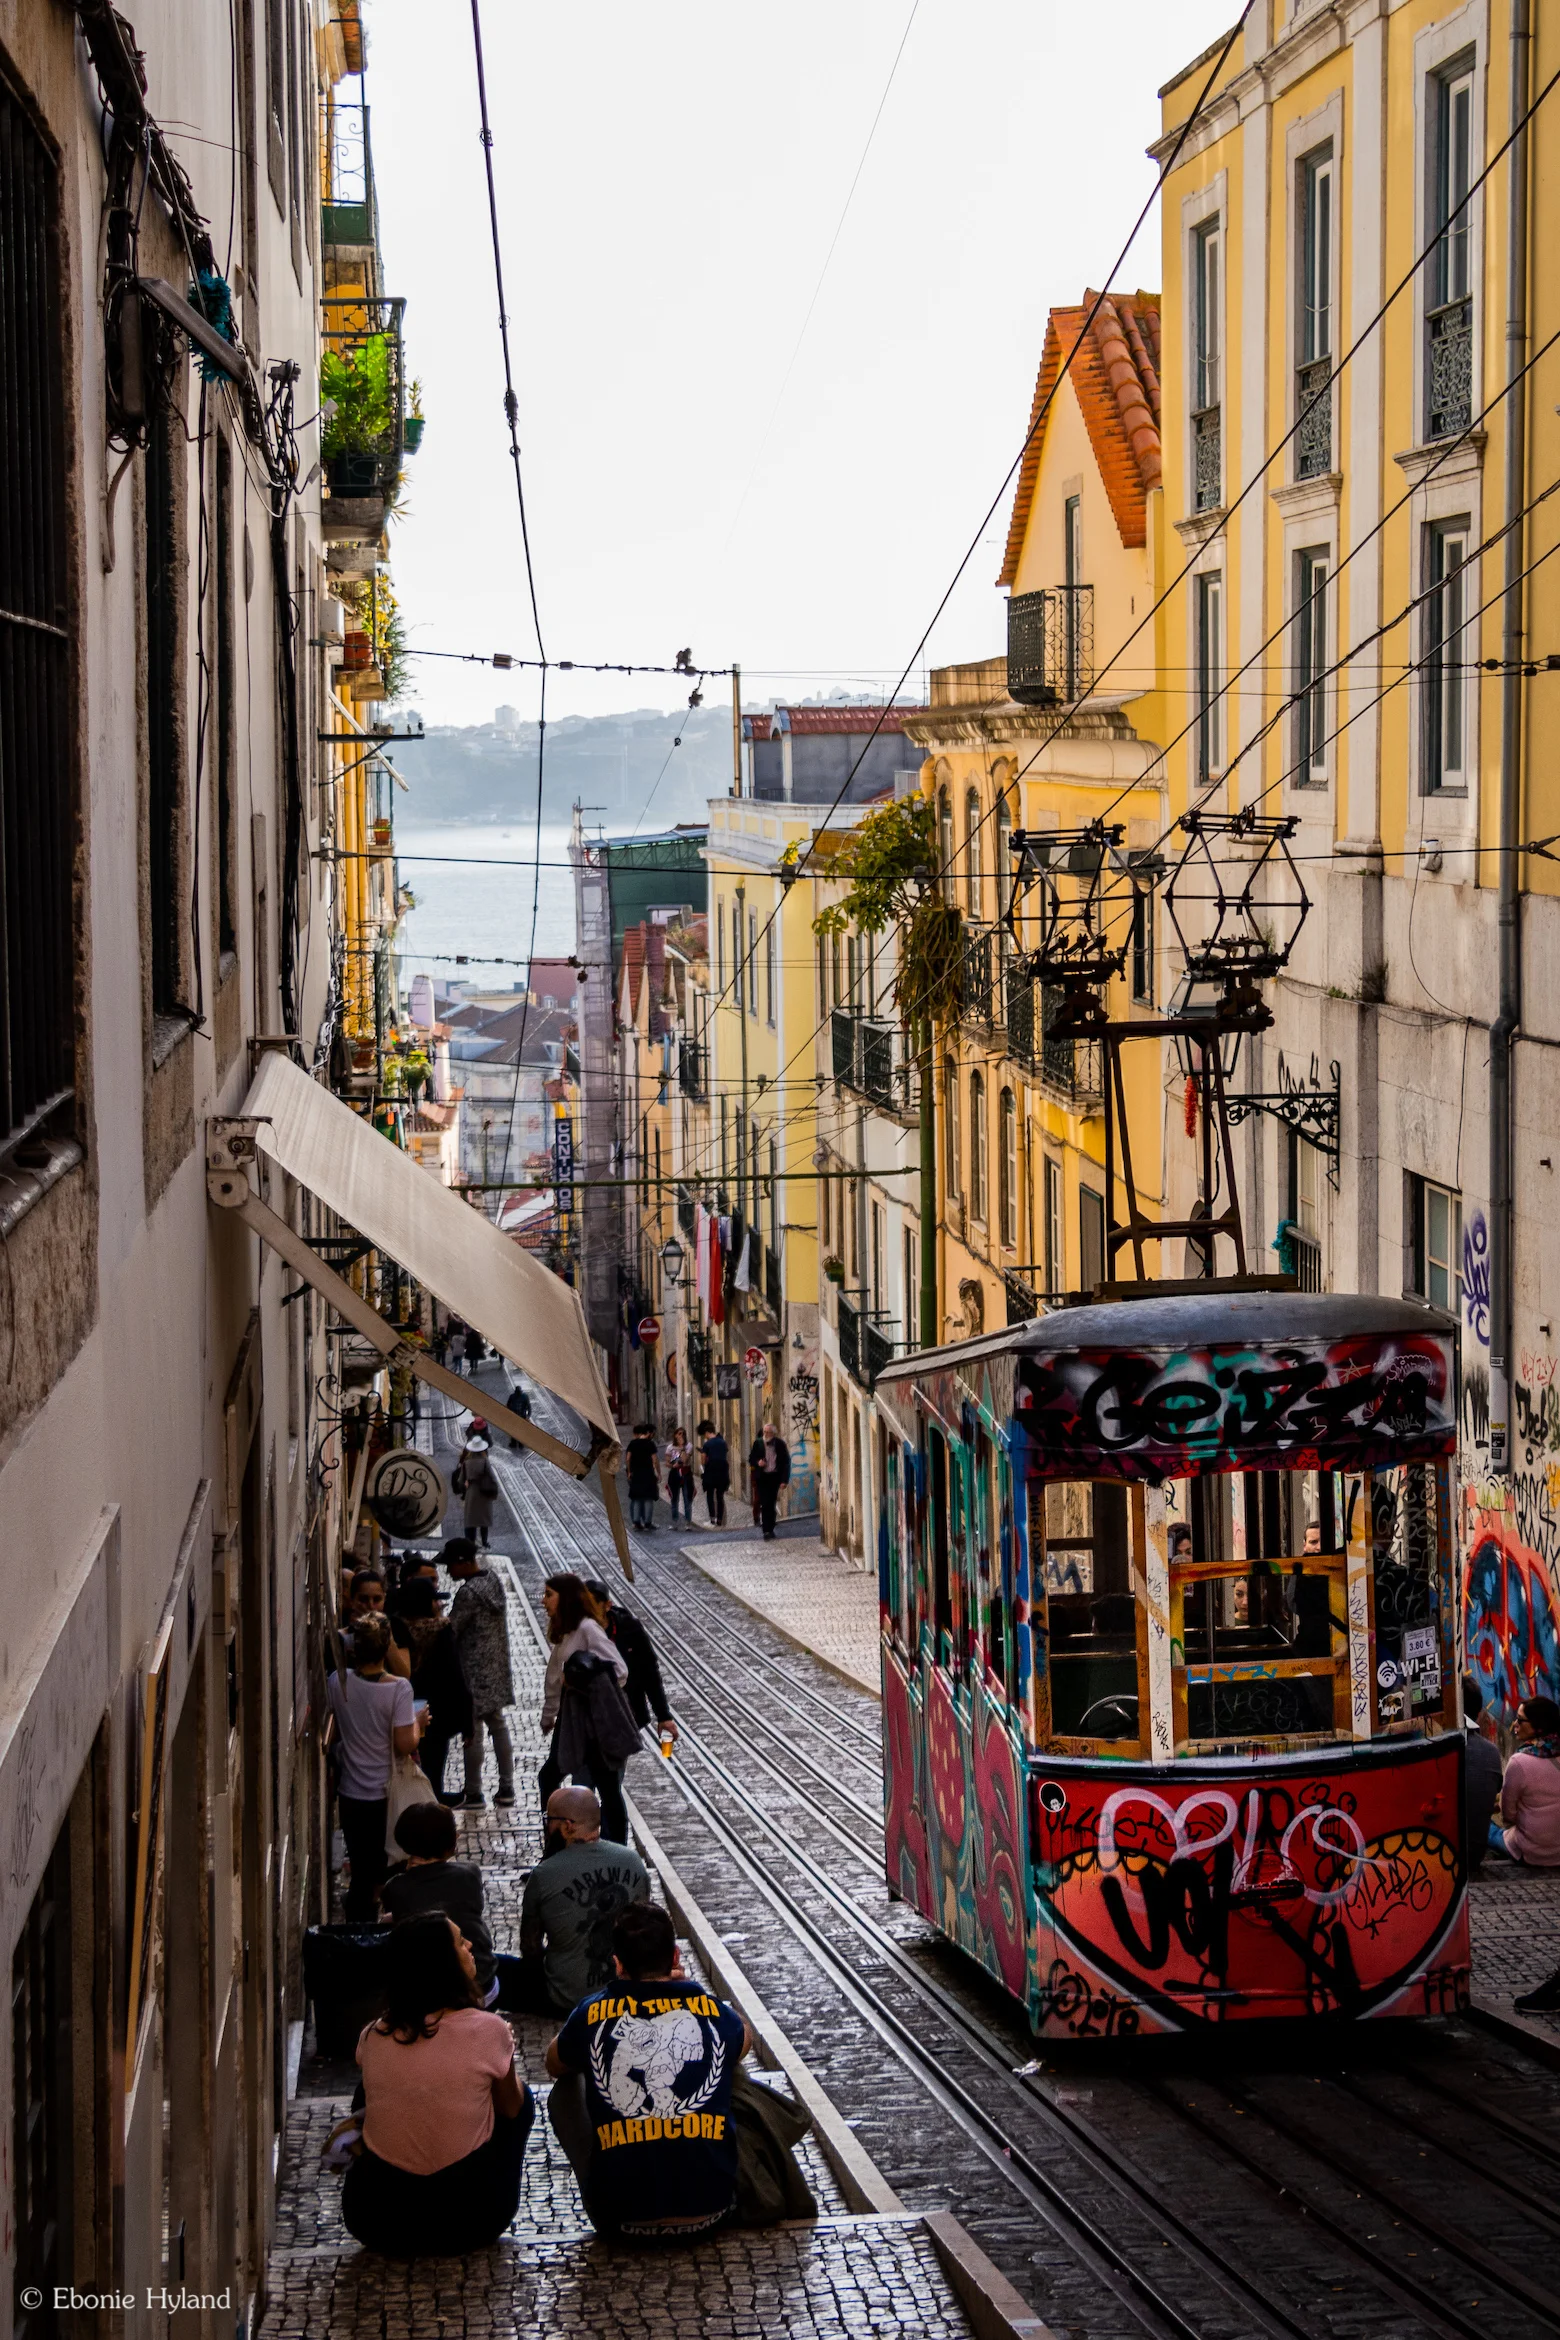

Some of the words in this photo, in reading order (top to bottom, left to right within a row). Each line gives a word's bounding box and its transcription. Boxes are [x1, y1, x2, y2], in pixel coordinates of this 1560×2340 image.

[1409, 1640, 1424, 1651] 3.80
[1425, 1638, 1431, 1647] €
[1400, 1653, 1439, 1677] WI-FI
[562, 1867, 641, 1901] PARKWAY
[587, 1995, 640, 2026] BILLY
[642, 1997, 684, 2014] THE
[685, 1994, 720, 2018] KID
[614, 2016, 637, 2038] BTK
[596, 2113, 726, 2151] HARDCORE
